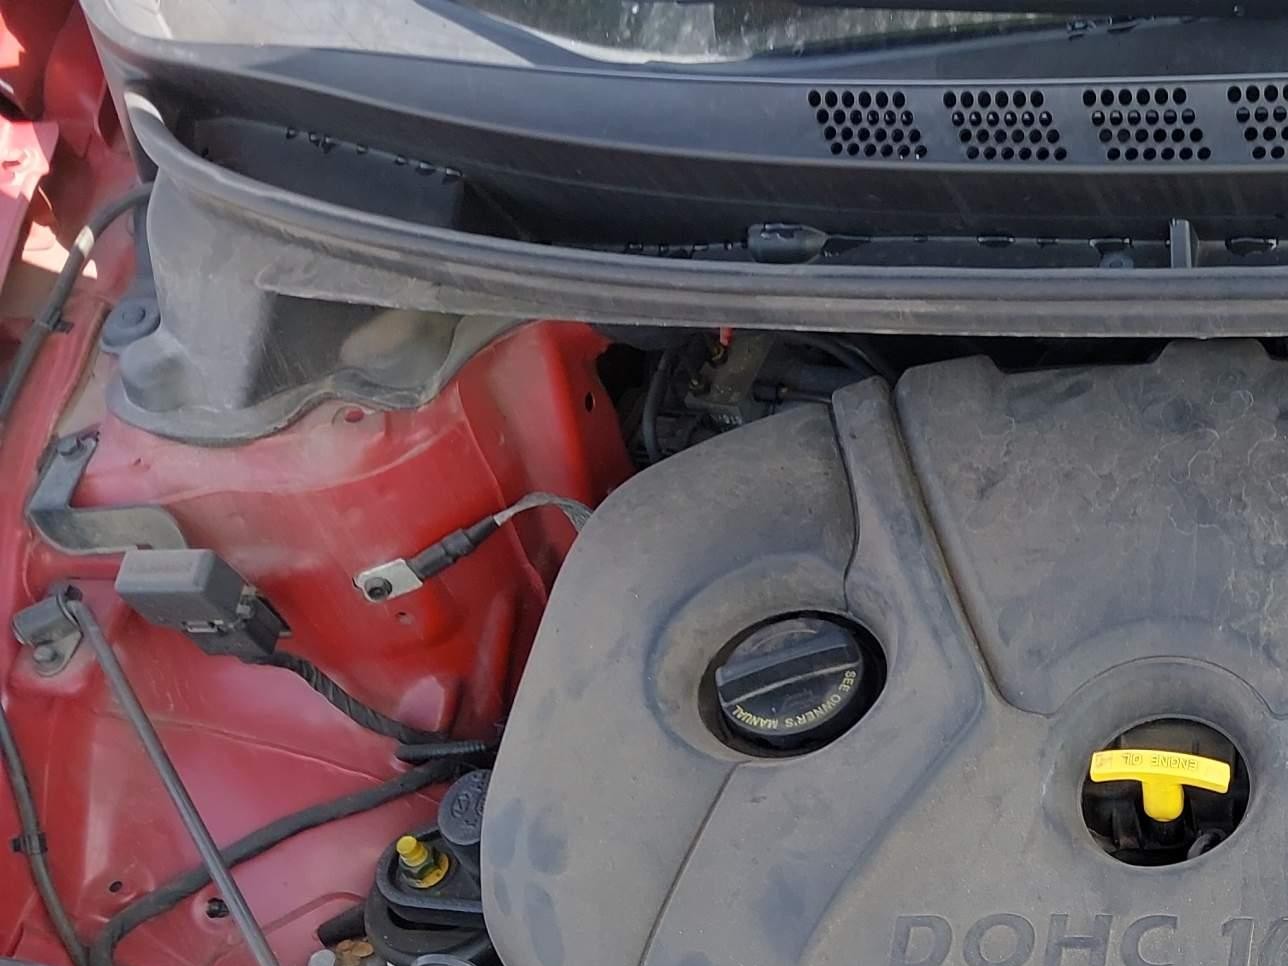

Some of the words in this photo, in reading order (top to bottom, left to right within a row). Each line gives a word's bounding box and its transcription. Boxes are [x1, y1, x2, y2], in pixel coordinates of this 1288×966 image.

[838, 670, 857, 692] SEE
[732, 705, 778, 729] MANUAL
[785, 694, 841, 728] OWNER'S
[1121, 752, 1143, 765] OIL
[1151, 758, 1199, 769] ENGINE
